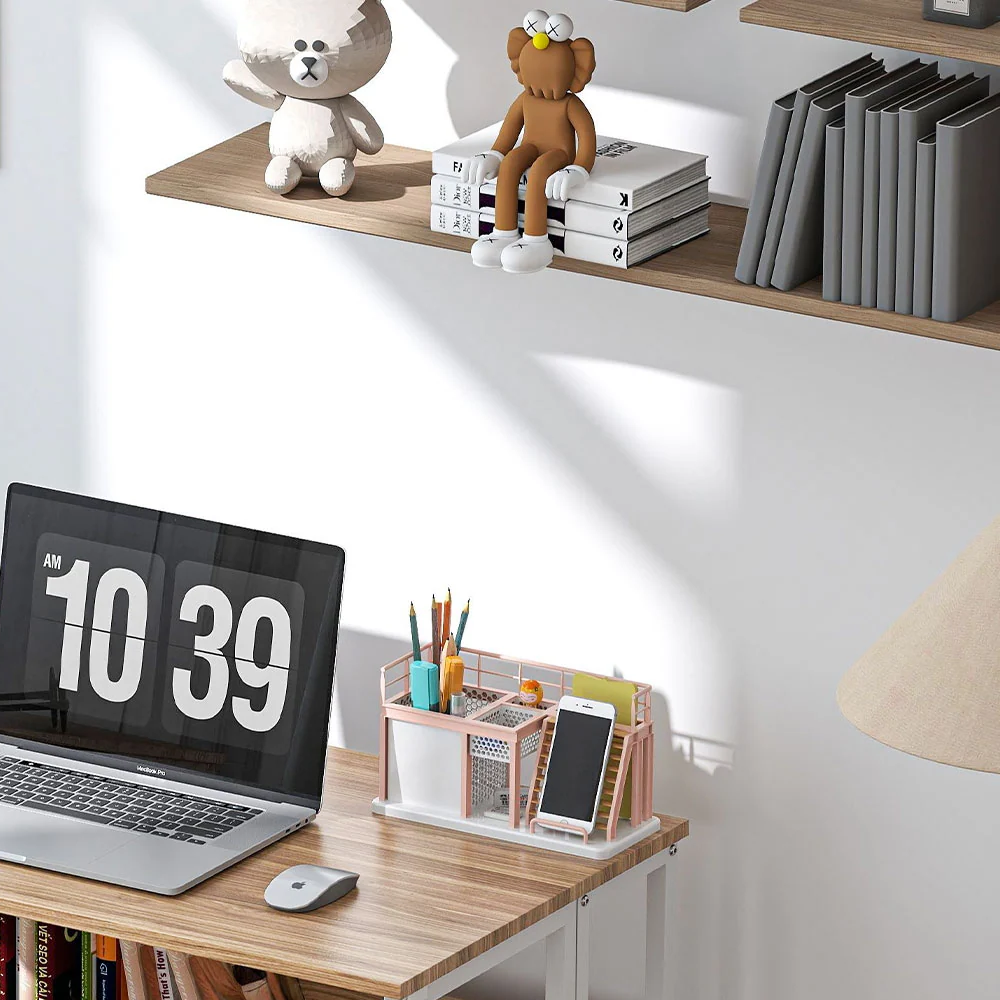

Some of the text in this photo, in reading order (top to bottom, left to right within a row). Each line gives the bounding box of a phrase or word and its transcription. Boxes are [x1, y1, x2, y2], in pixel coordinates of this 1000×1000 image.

[43, 552, 62, 570] AM
[45, 559, 292, 733] 10 39
[38, 925, 52, 943] VẾT
[38, 966, 52, 978] VÀ
[156, 950, 170, 1000] That's How
[38, 980, 51, 996] CÁI
